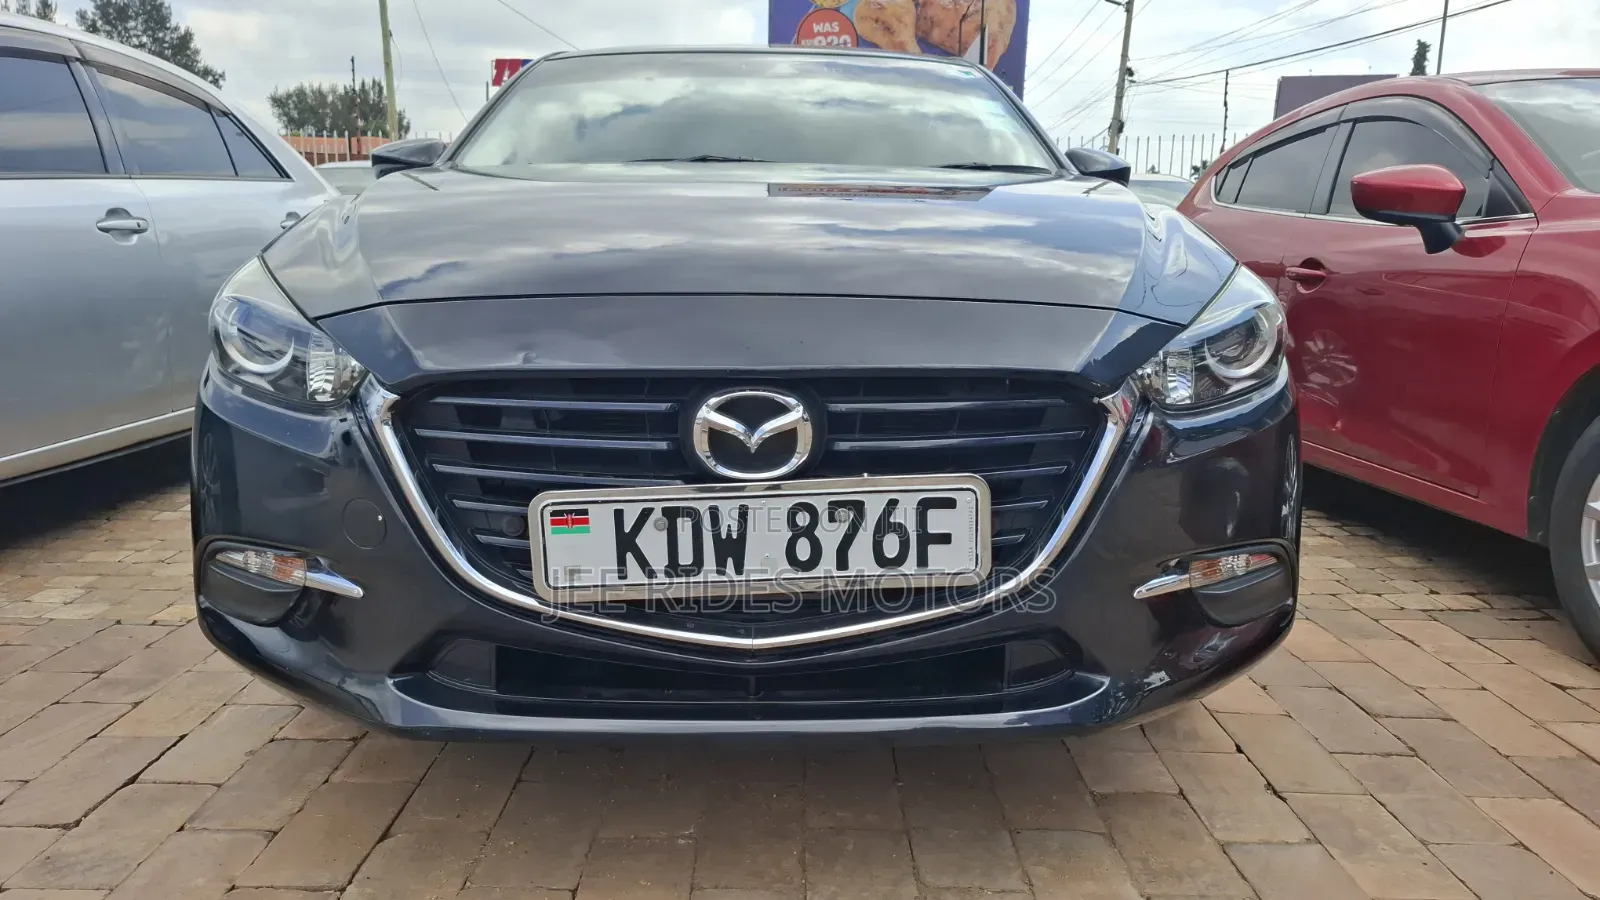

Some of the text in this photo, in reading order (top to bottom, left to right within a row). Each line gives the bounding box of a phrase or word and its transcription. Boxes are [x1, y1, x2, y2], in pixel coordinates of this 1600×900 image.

[813, 22, 840, 33] WAS
[613, 503, 749, 580] KDW
[785, 496, 958, 573] 876F
